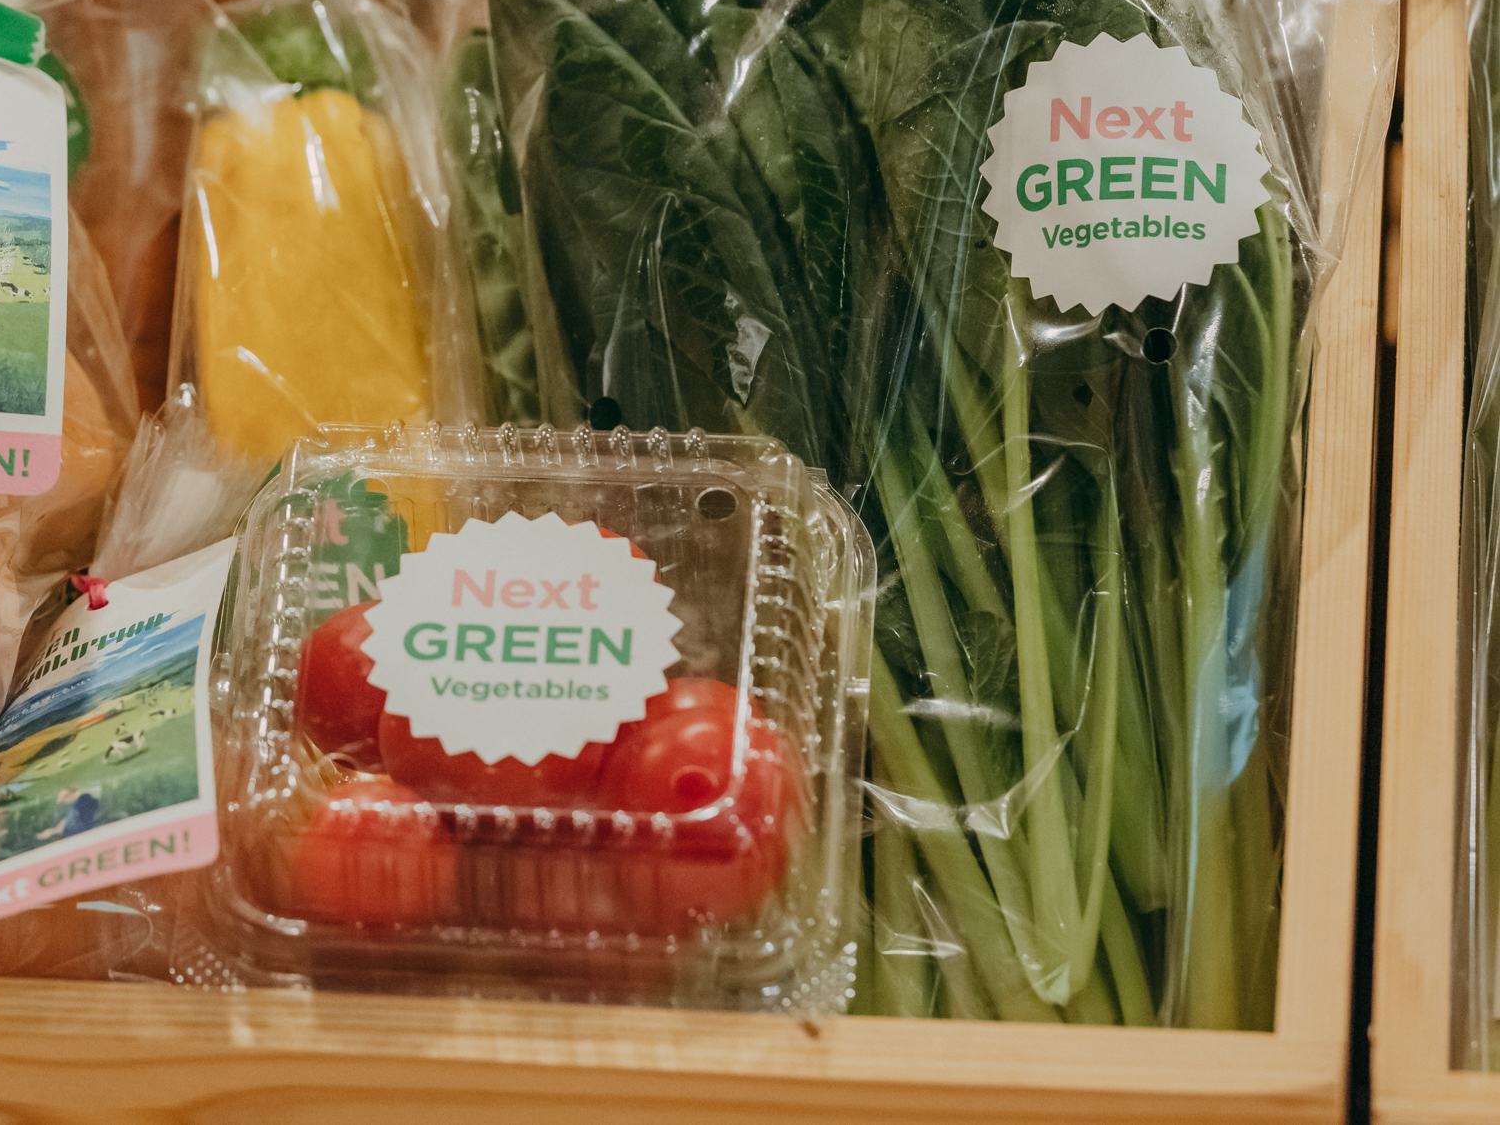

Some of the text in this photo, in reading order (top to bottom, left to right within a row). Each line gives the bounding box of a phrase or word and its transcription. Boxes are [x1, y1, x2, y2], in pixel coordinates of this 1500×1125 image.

[1050, 96, 1194, 143] Next
[1016, 156, 1227, 212] GREEN
[1041, 214, 1207, 249] Vegetables
[451, 568, 601, 611] Next
[403, 622, 634, 666] GREEN
[430, 676, 610, 702] Vegetables
[38, 829, 190, 889] GREEN!
